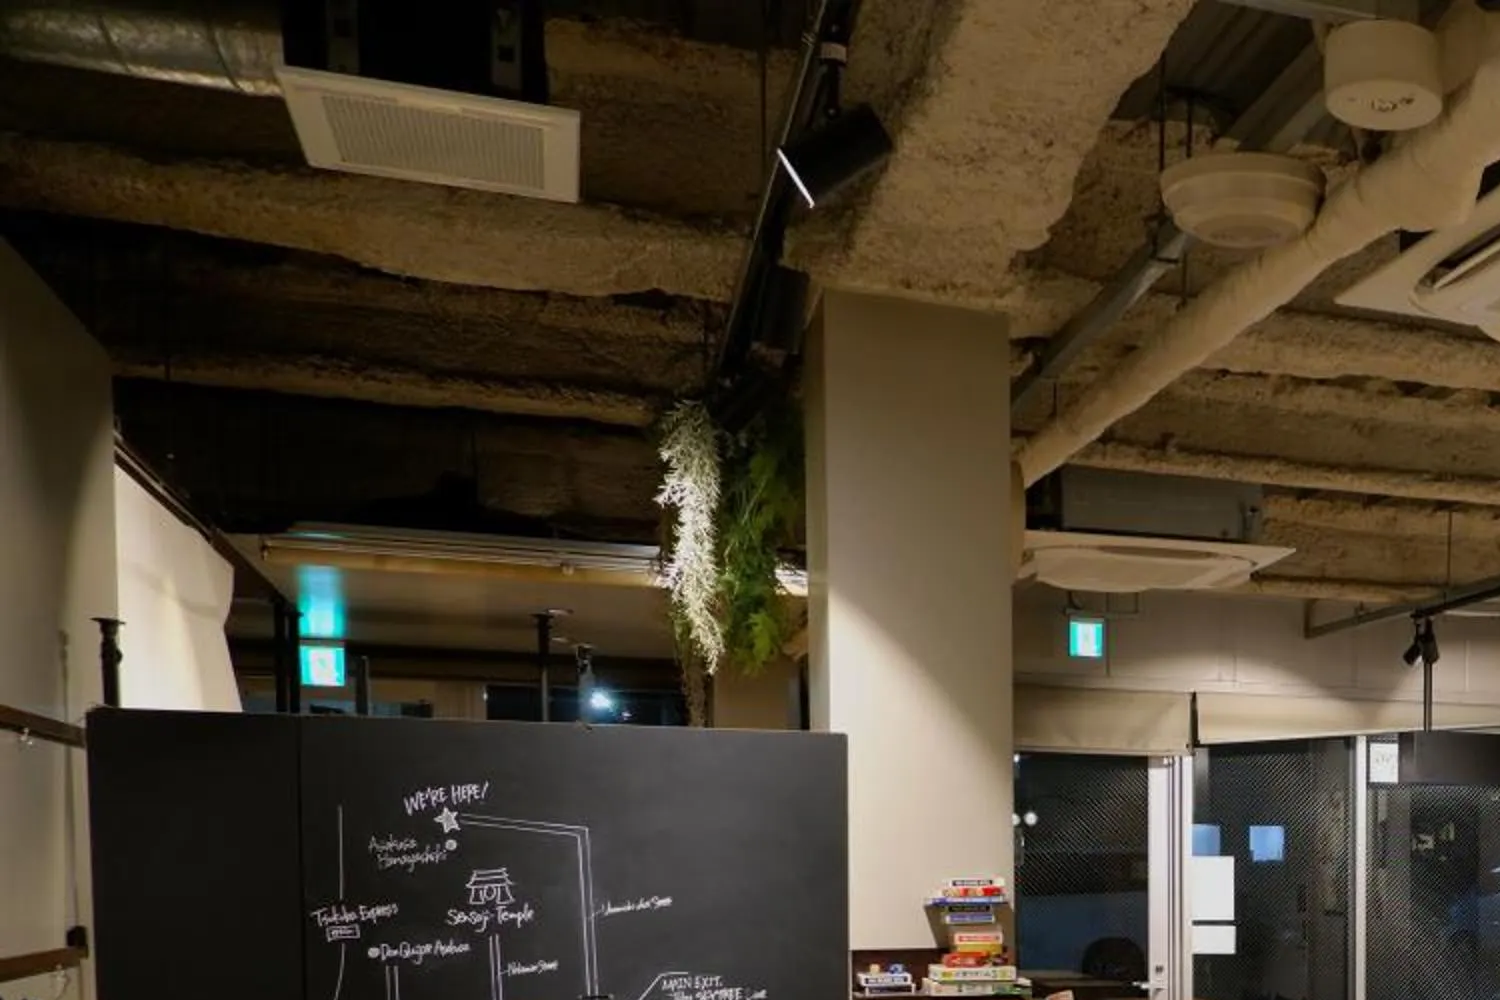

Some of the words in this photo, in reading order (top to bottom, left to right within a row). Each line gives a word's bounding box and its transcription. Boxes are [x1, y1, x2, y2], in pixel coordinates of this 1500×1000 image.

[404, 786, 449, 816] WE'RE
[451, 780, 489, 805] HERE!
[495, 902, 534, 929] Temple
